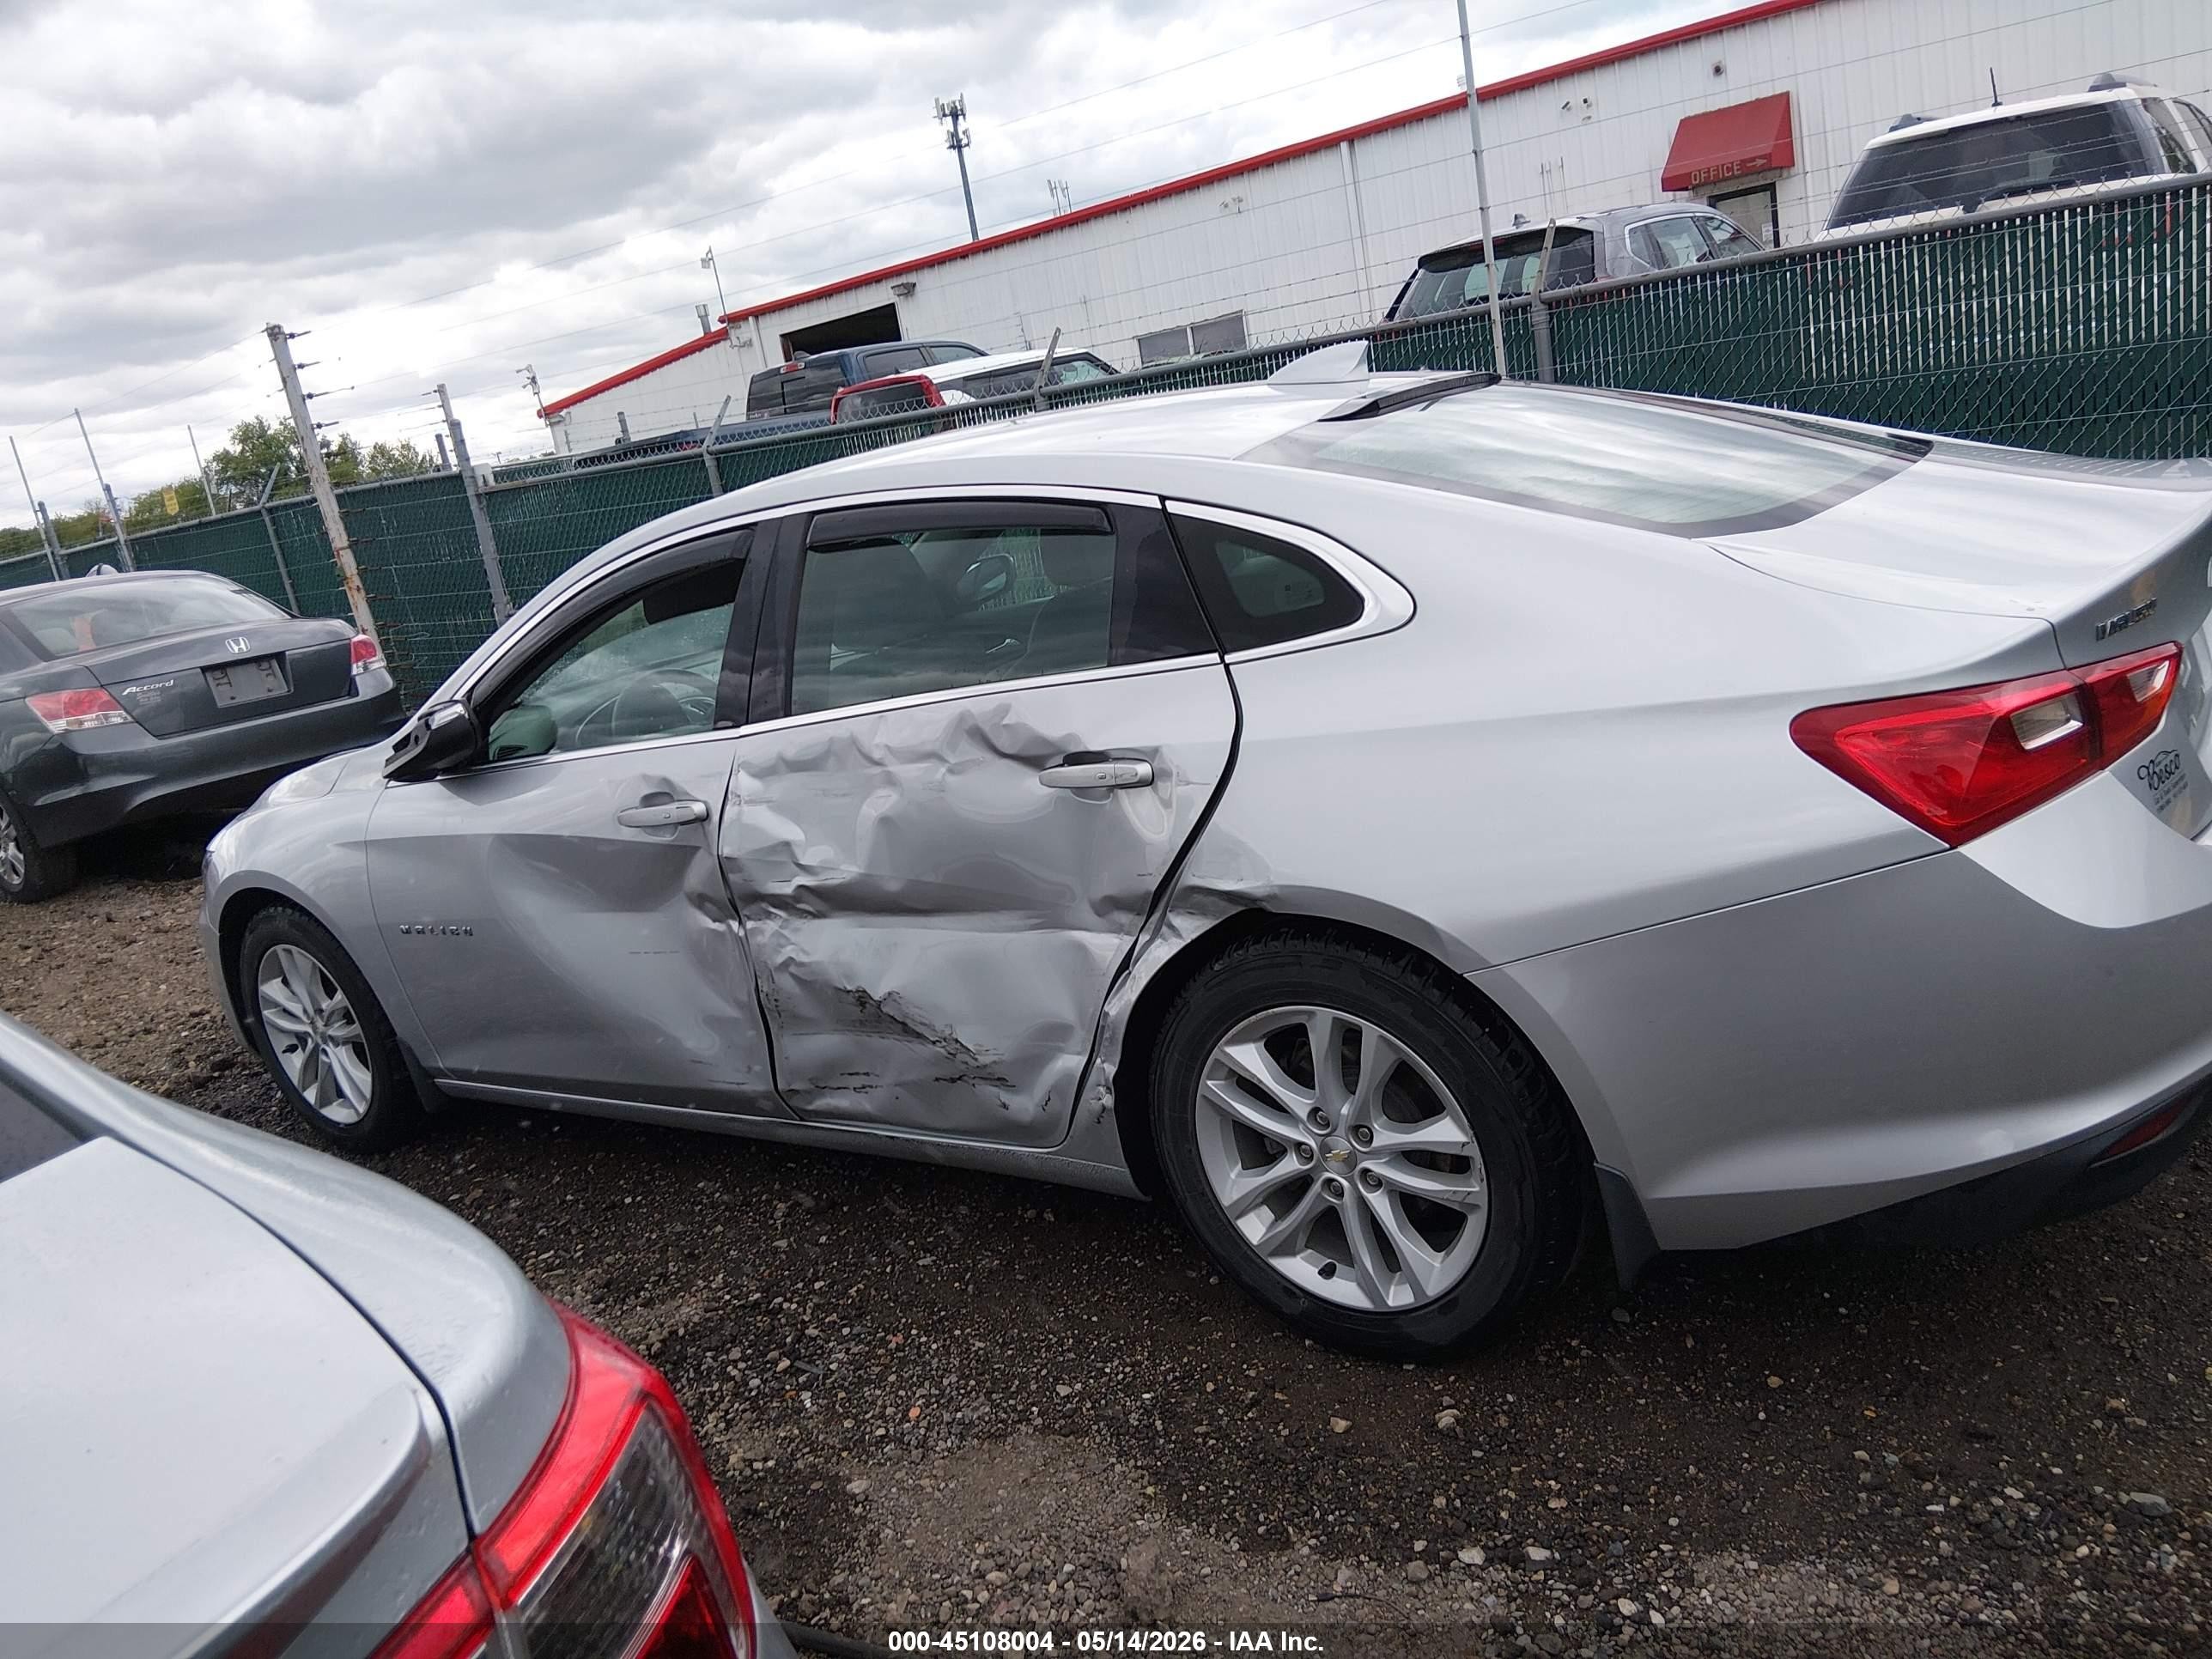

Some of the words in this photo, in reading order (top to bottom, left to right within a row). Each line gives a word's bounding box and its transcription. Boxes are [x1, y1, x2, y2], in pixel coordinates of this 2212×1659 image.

[1691, 161, 1743, 185] OFFICE
[121, 679, 174, 696] Accord
[2137, 753, 2181, 791] Besco
